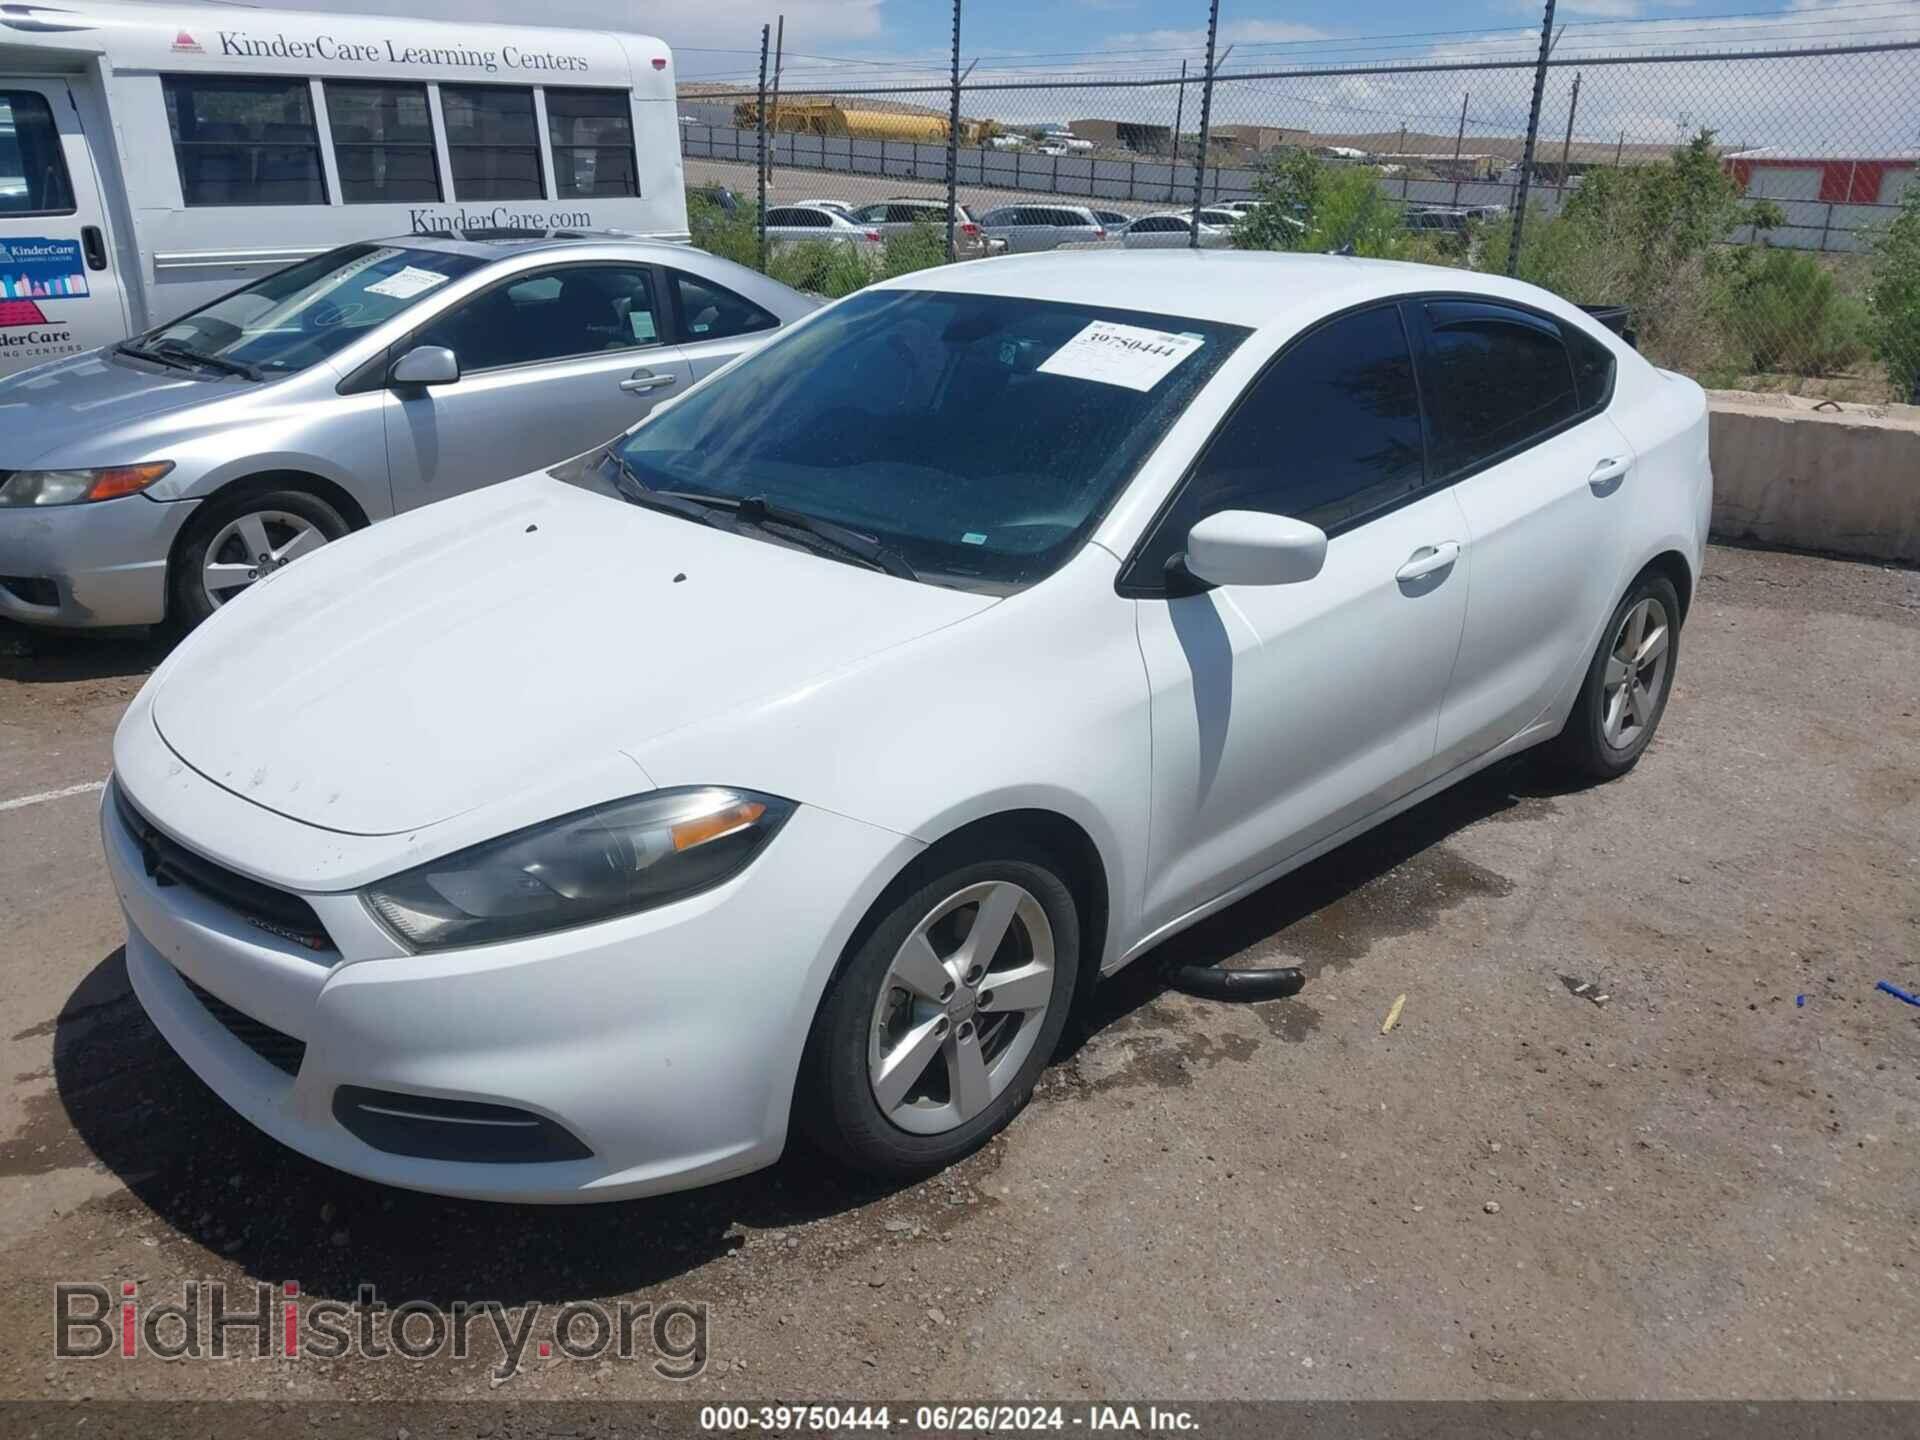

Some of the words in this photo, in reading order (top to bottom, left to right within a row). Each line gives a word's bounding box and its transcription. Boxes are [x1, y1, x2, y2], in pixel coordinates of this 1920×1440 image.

[218, 31, 379, 61] KinderCare
[384, 39, 497, 72] Learning
[502, 46, 589, 71] Centers
[408, 208, 592, 232] KinderCare.com
[11, 245, 74, 256] KinderCare
[26, 345, 82, 356] CENTERS
